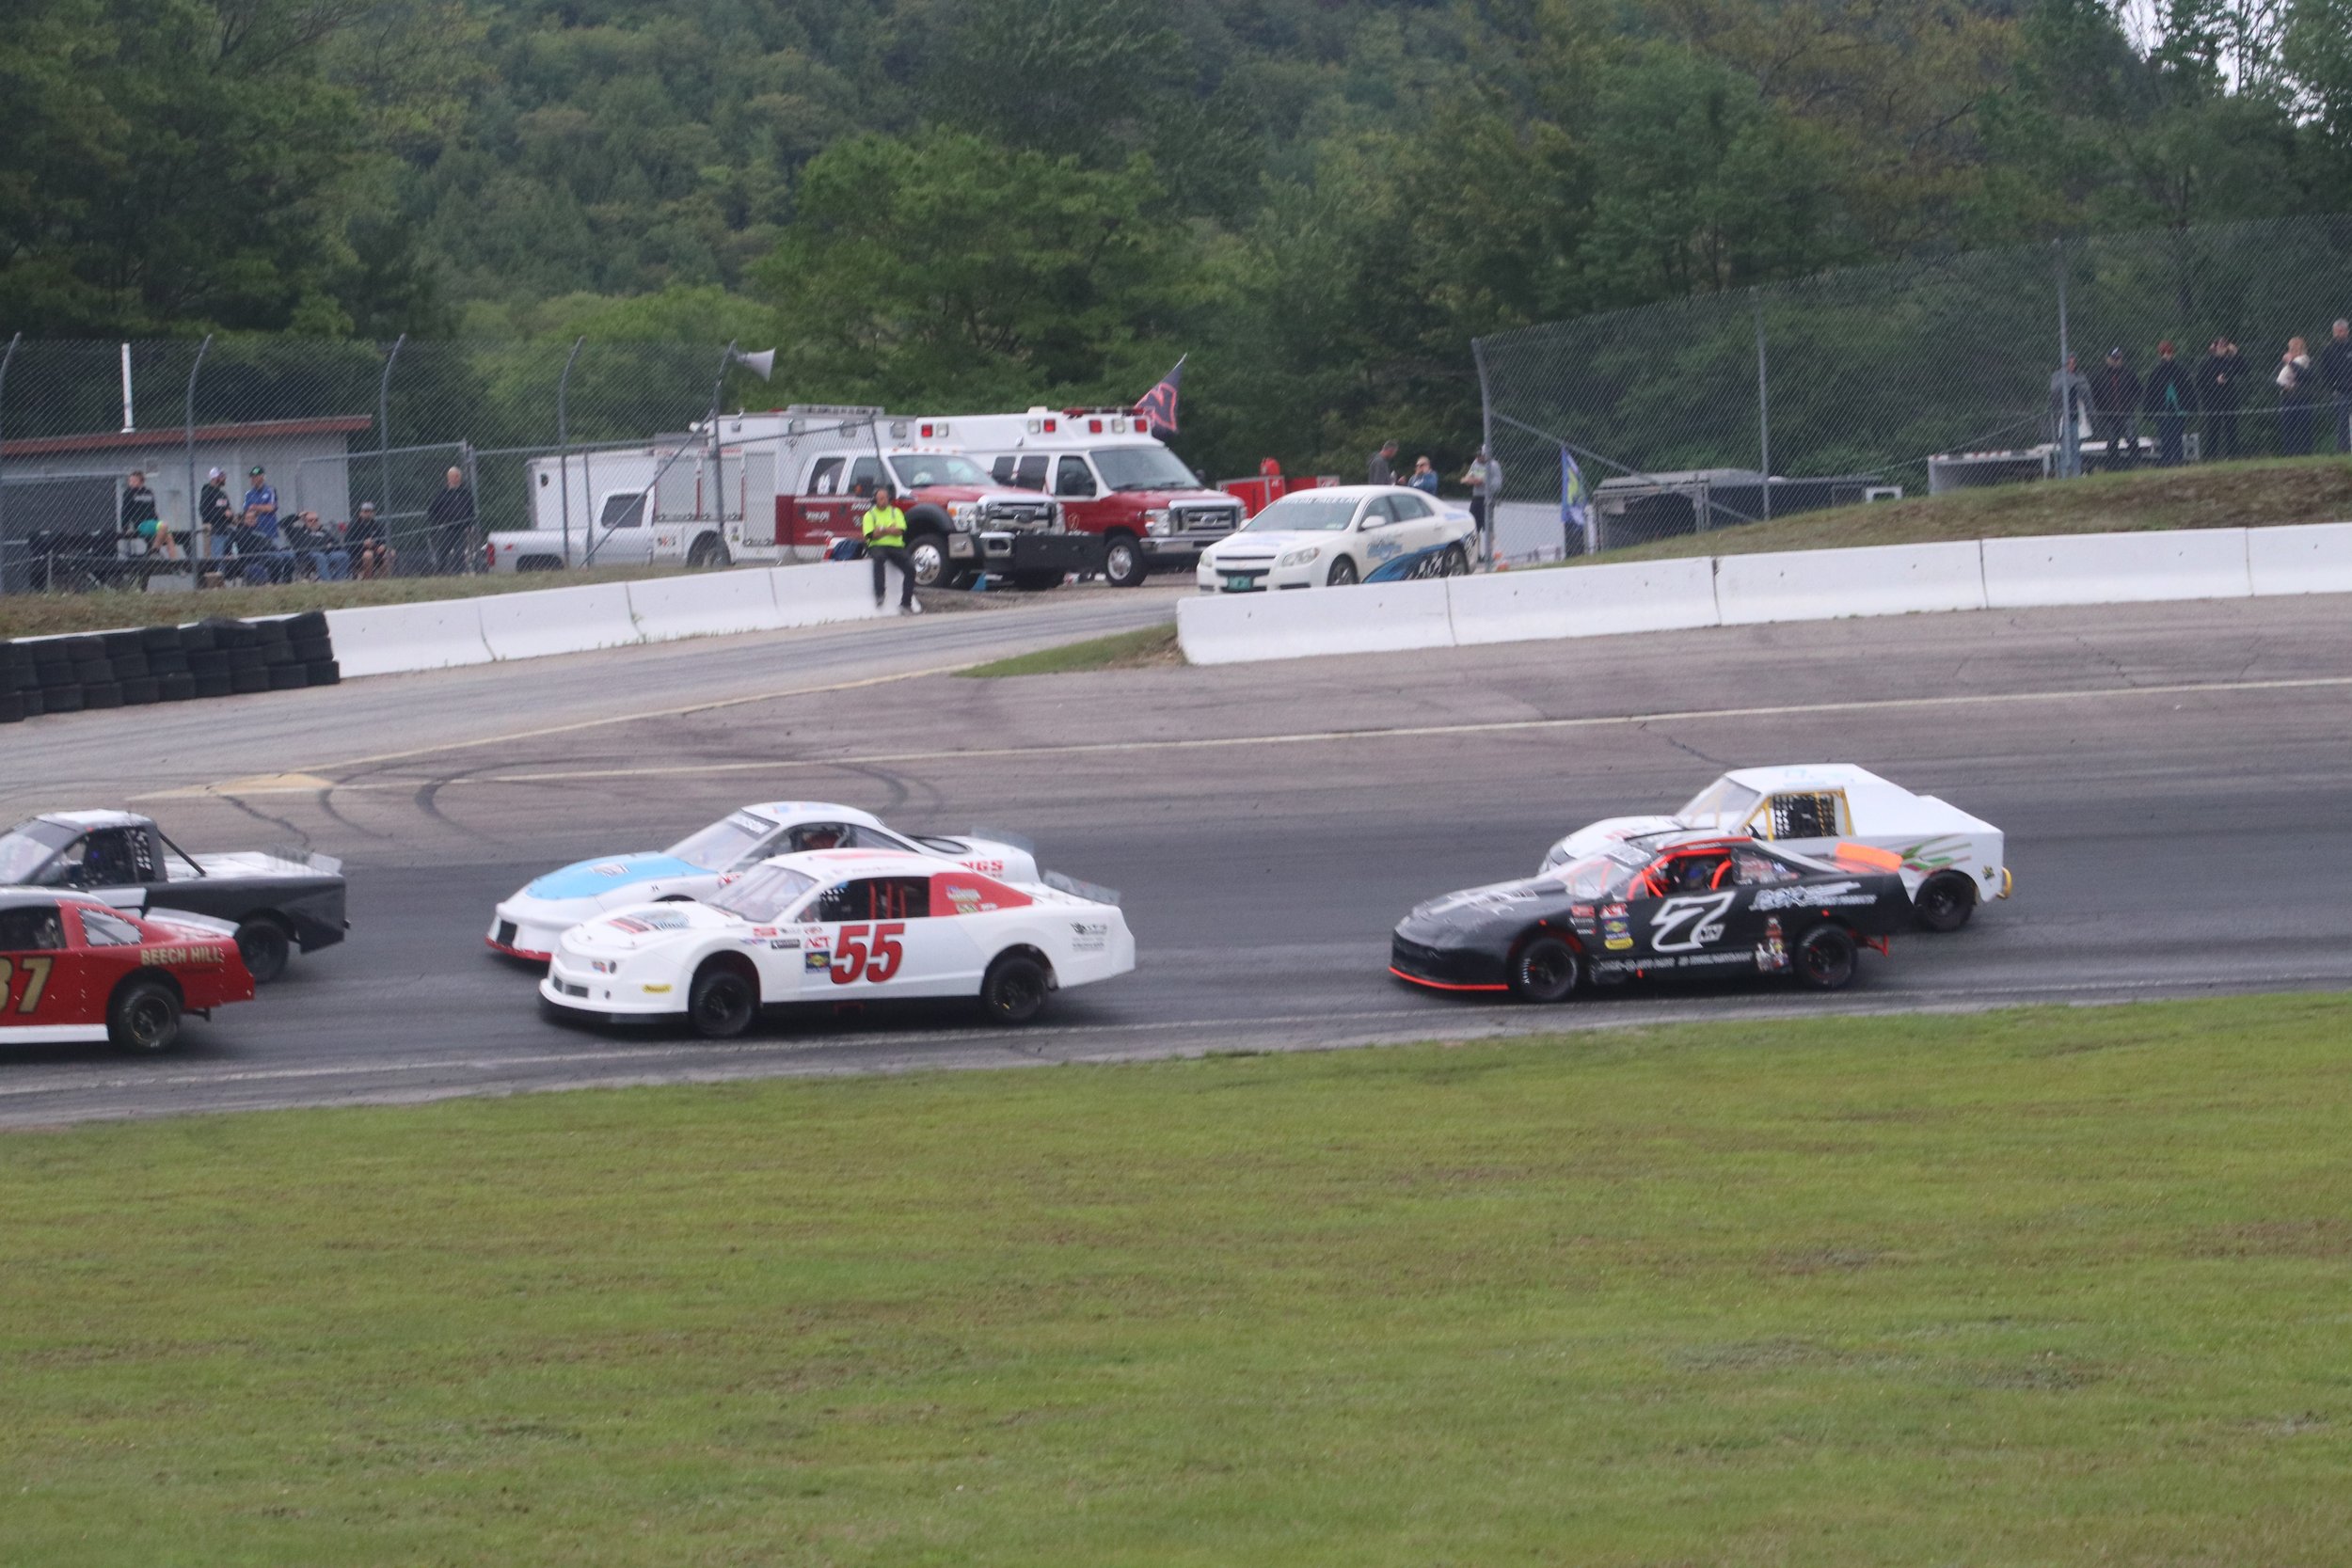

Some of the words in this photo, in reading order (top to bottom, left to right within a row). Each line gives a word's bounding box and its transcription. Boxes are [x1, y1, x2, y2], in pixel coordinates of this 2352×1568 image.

[803, 936, 832, 949] ACT
[140, 947, 187, 966] BEECH
[189, 945, 222, 964] HILL
[831, 923, 905, 985] 55
